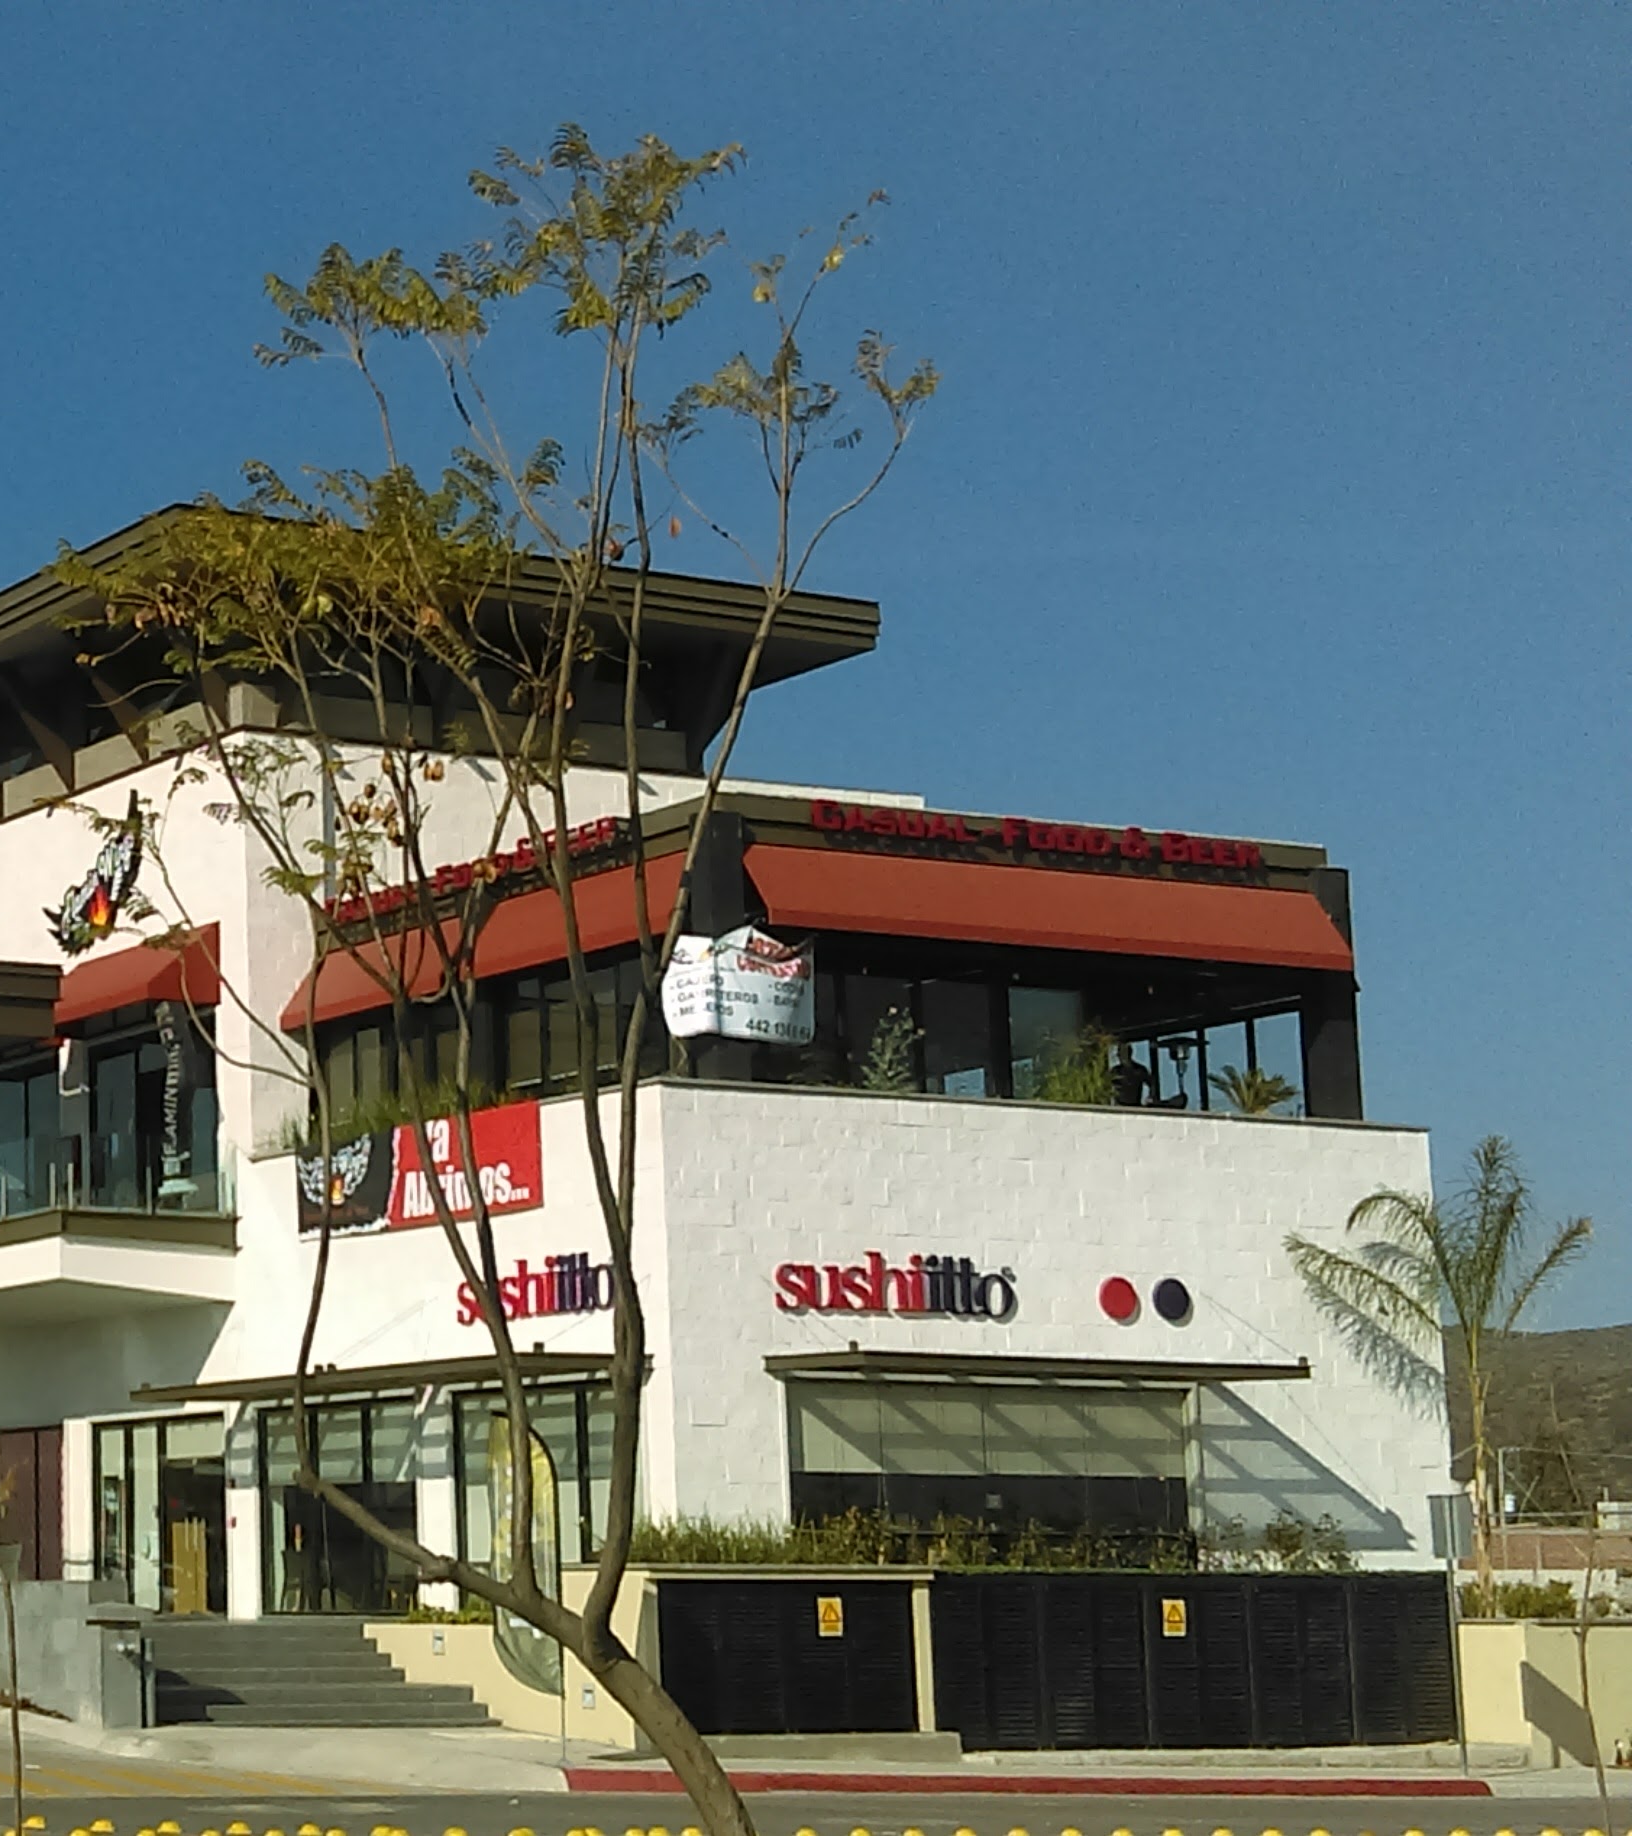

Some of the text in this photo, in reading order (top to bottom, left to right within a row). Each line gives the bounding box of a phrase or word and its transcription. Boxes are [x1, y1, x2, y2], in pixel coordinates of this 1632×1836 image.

[811, 799, 975, 843] CASUAL
[1002, 817, 1112, 857] FOOD
[1120, 827, 1151, 859] &
[1161, 832, 1261, 868] BEER
[433, 853, 517, 893] FOD
[456, 1252, 615, 1328] sshiitto
[774, 1250, 1015, 1318] sushiitto
